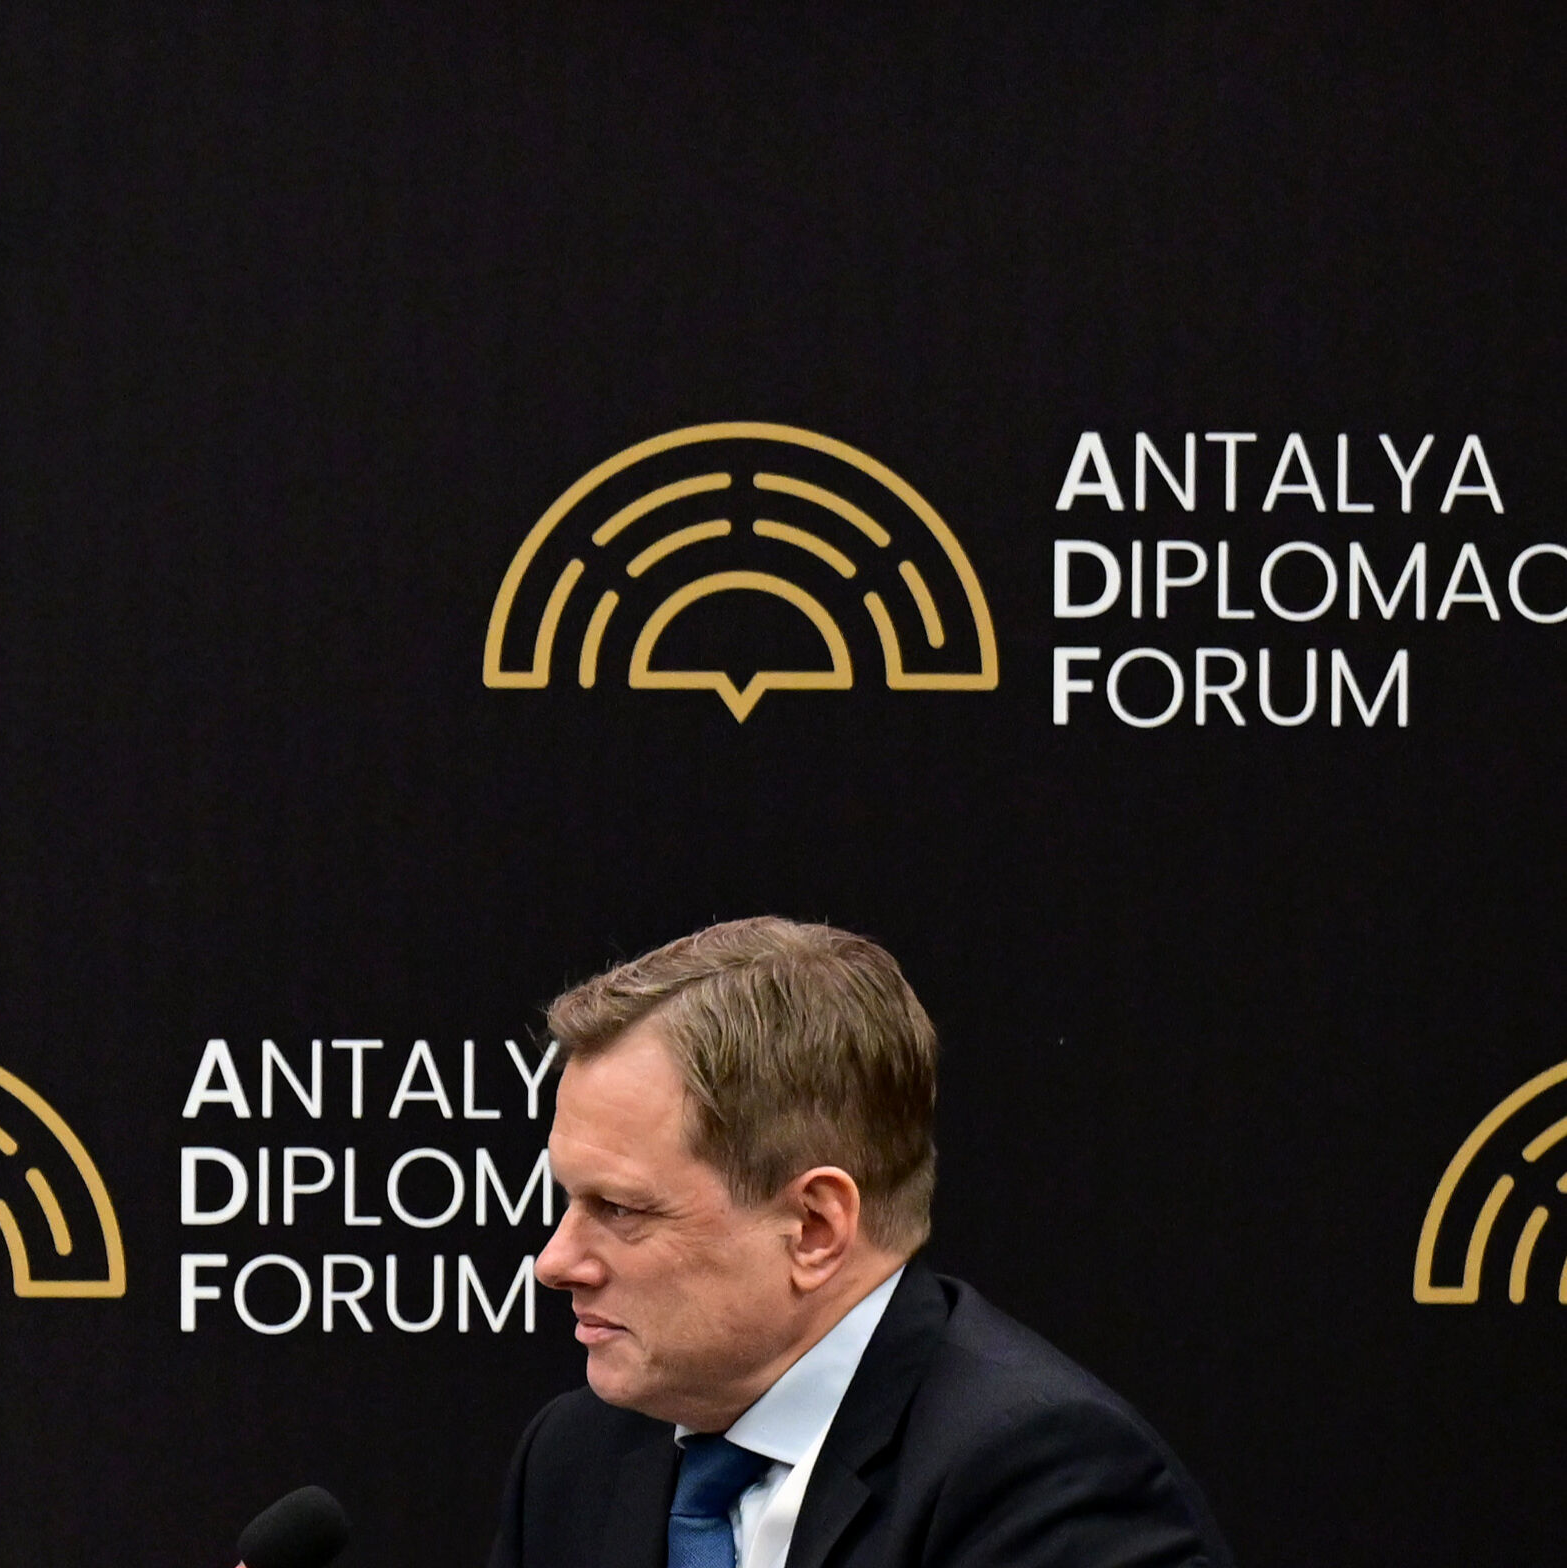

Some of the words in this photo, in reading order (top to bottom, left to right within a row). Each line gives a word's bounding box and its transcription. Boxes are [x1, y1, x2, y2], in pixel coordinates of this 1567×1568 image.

[1055, 431, 1504, 514] ANTALYA
[1053, 539, 1567, 624] DIPLOMAC
[1052, 646, 1409, 729] FORUM
[181, 1038, 559, 1120] ANTALY
[180, 1146, 554, 1230] DIPLOM
[180, 1253, 537, 1335] FORUM
